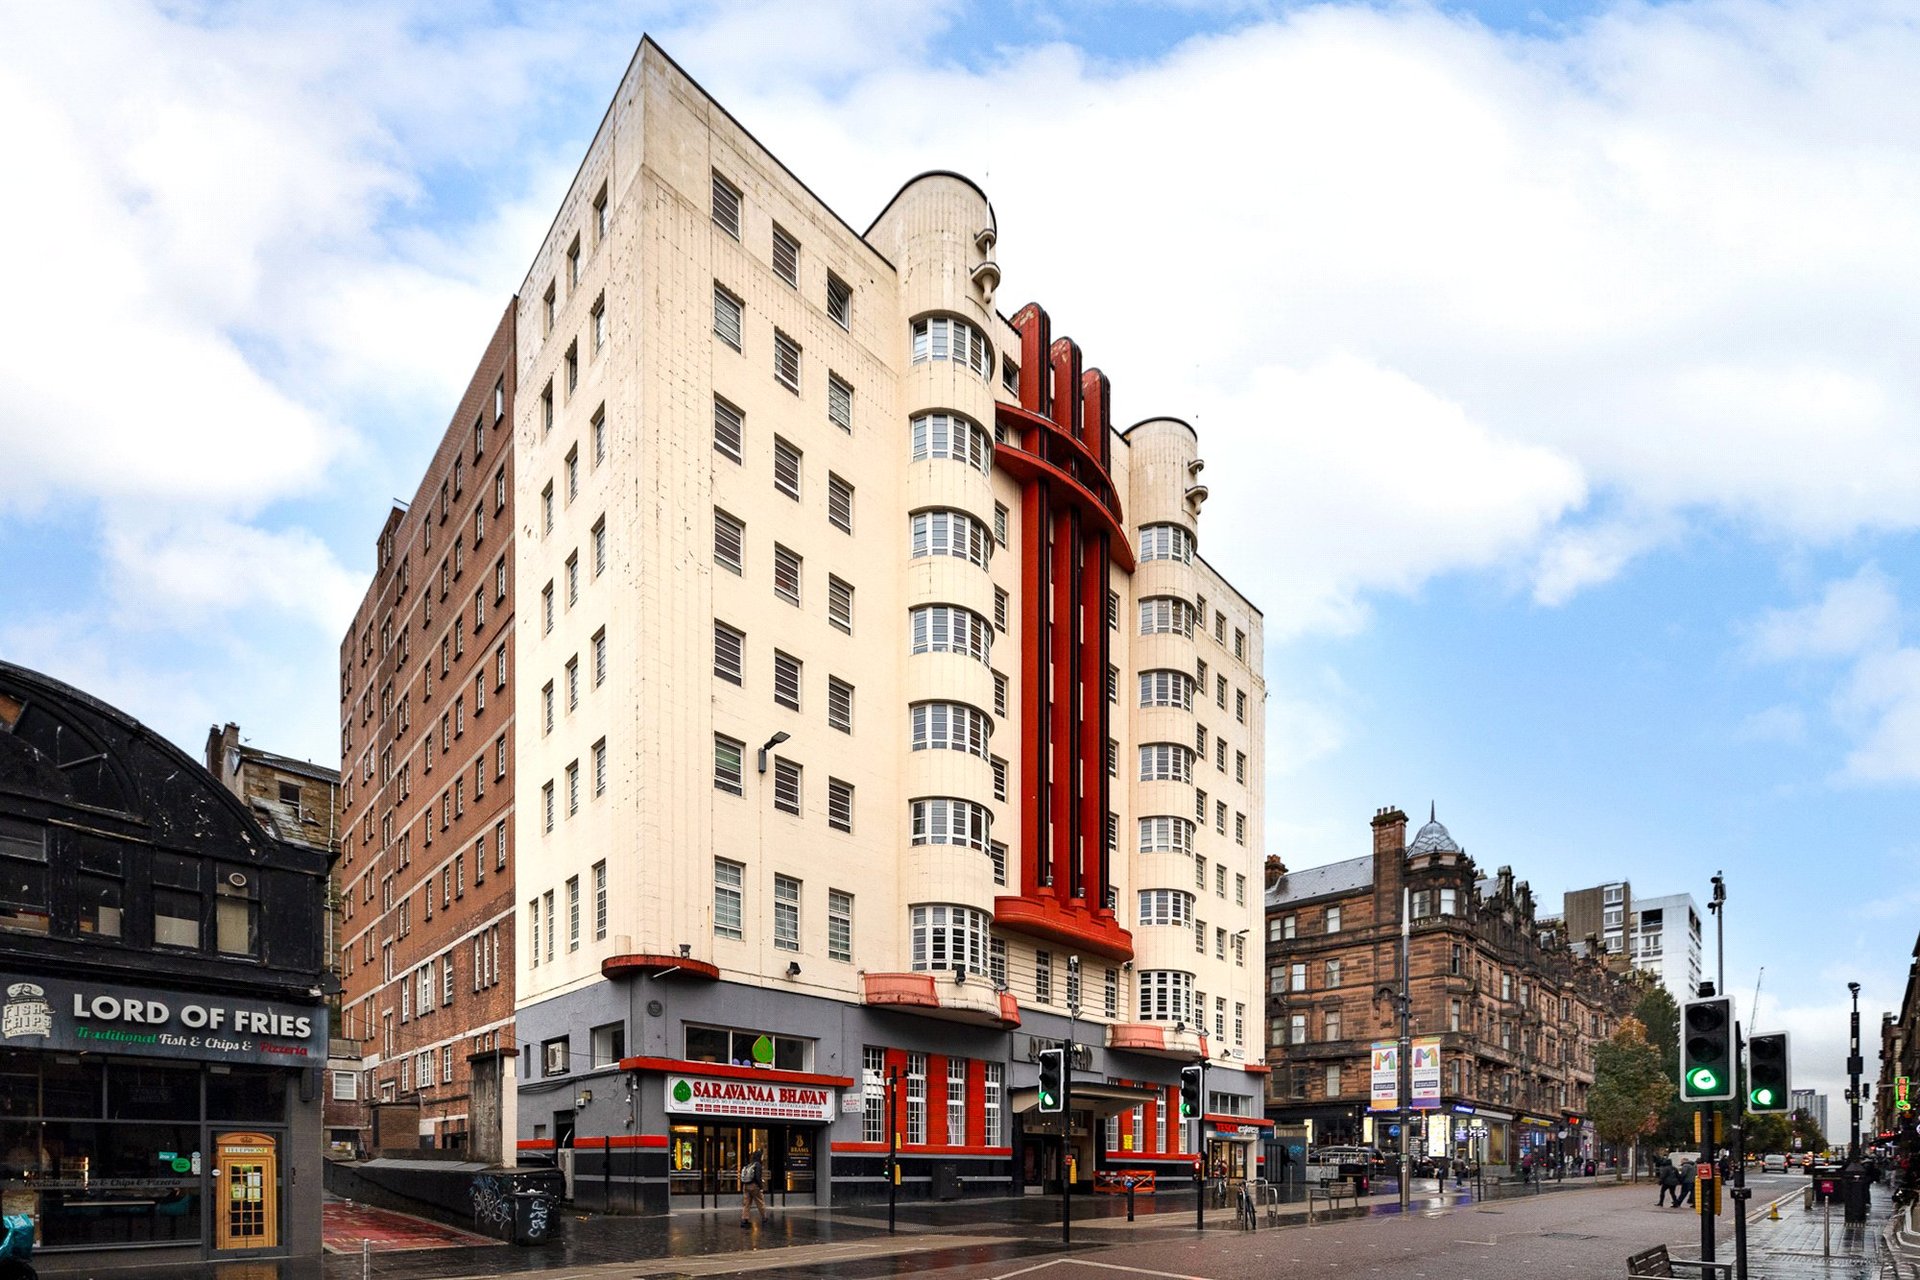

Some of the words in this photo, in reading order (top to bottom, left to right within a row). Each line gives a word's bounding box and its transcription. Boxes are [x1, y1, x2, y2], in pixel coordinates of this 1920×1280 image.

[4, 1003, 42, 1019] FISH
[74, 993, 170, 1024] LORD
[181, 1005, 225, 1029] OF
[235, 1010, 311, 1038] FRIES
[3, 1016, 52, 1032] CHIPS
[76, 1026, 157, 1044] Traditional
[159, 1033, 187, 1046] Fish
[190, 1036, 201, 1047] &
[205, 1037, 239, 1052] Chips
[242, 1041, 252, 1051] &
[693, 1081, 775, 1102] SARAVANAA
[779, 1088, 827, 1105] BHAVAN
